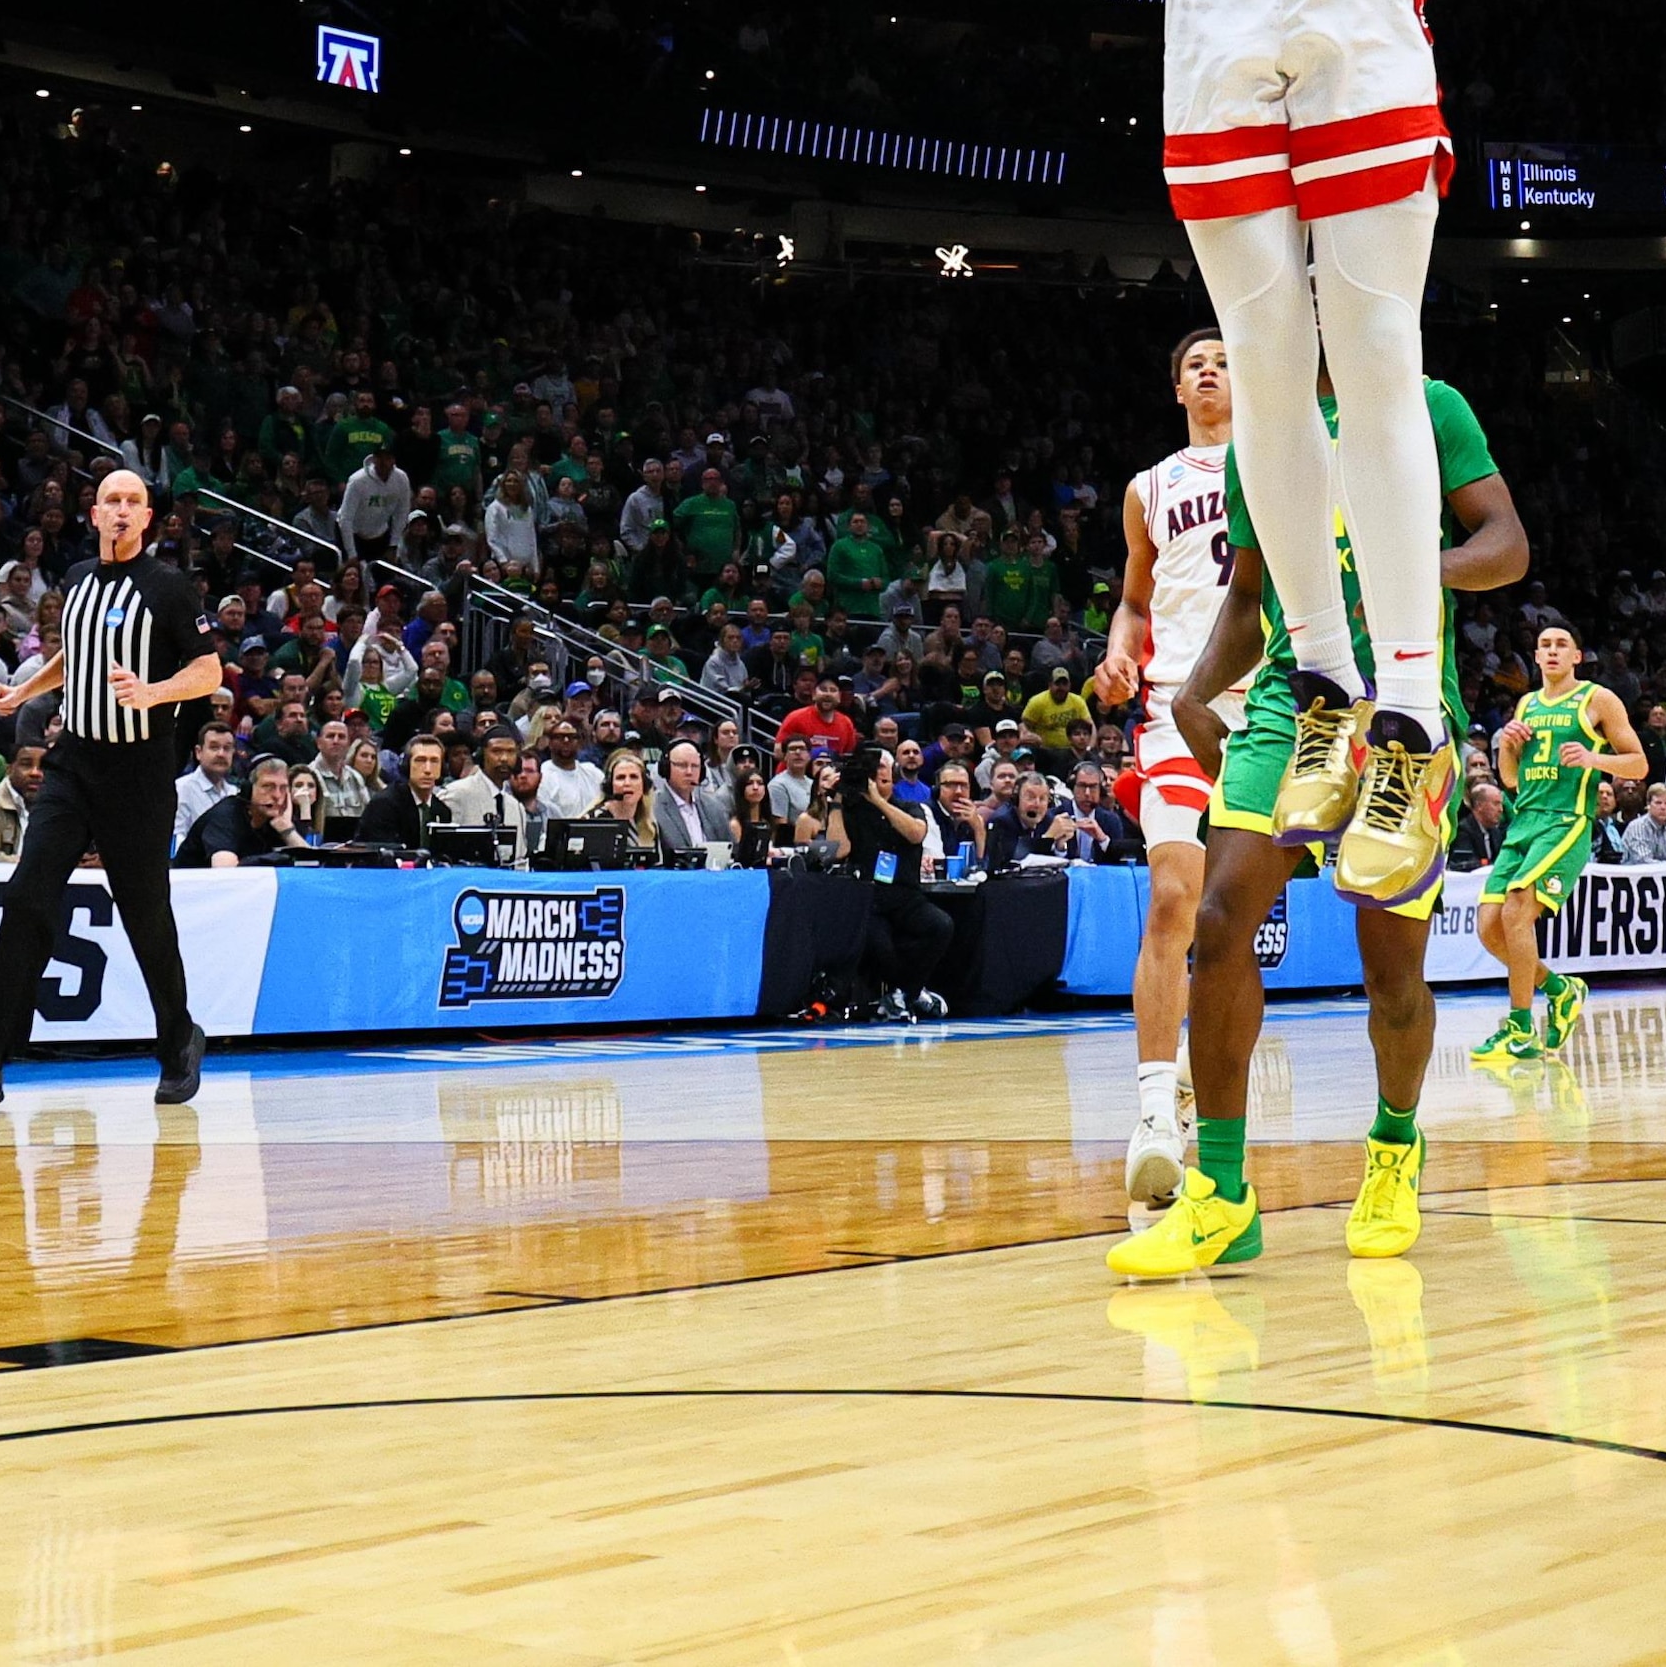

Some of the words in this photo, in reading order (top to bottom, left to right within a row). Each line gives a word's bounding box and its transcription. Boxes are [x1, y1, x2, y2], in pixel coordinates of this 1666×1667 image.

[1523, 163, 1576, 182] Illinois
[1525, 187, 1595, 209] Kentucky
[1211, 530, 1236, 587] 9
[1524, 714, 1573, 728] FIGHTING
[1533, 729, 1553, 764] 3
[1525, 766, 1559, 782] DUCKS
[486, 899, 576, 939] MARCH
[497, 941, 622, 982] MADNESS
